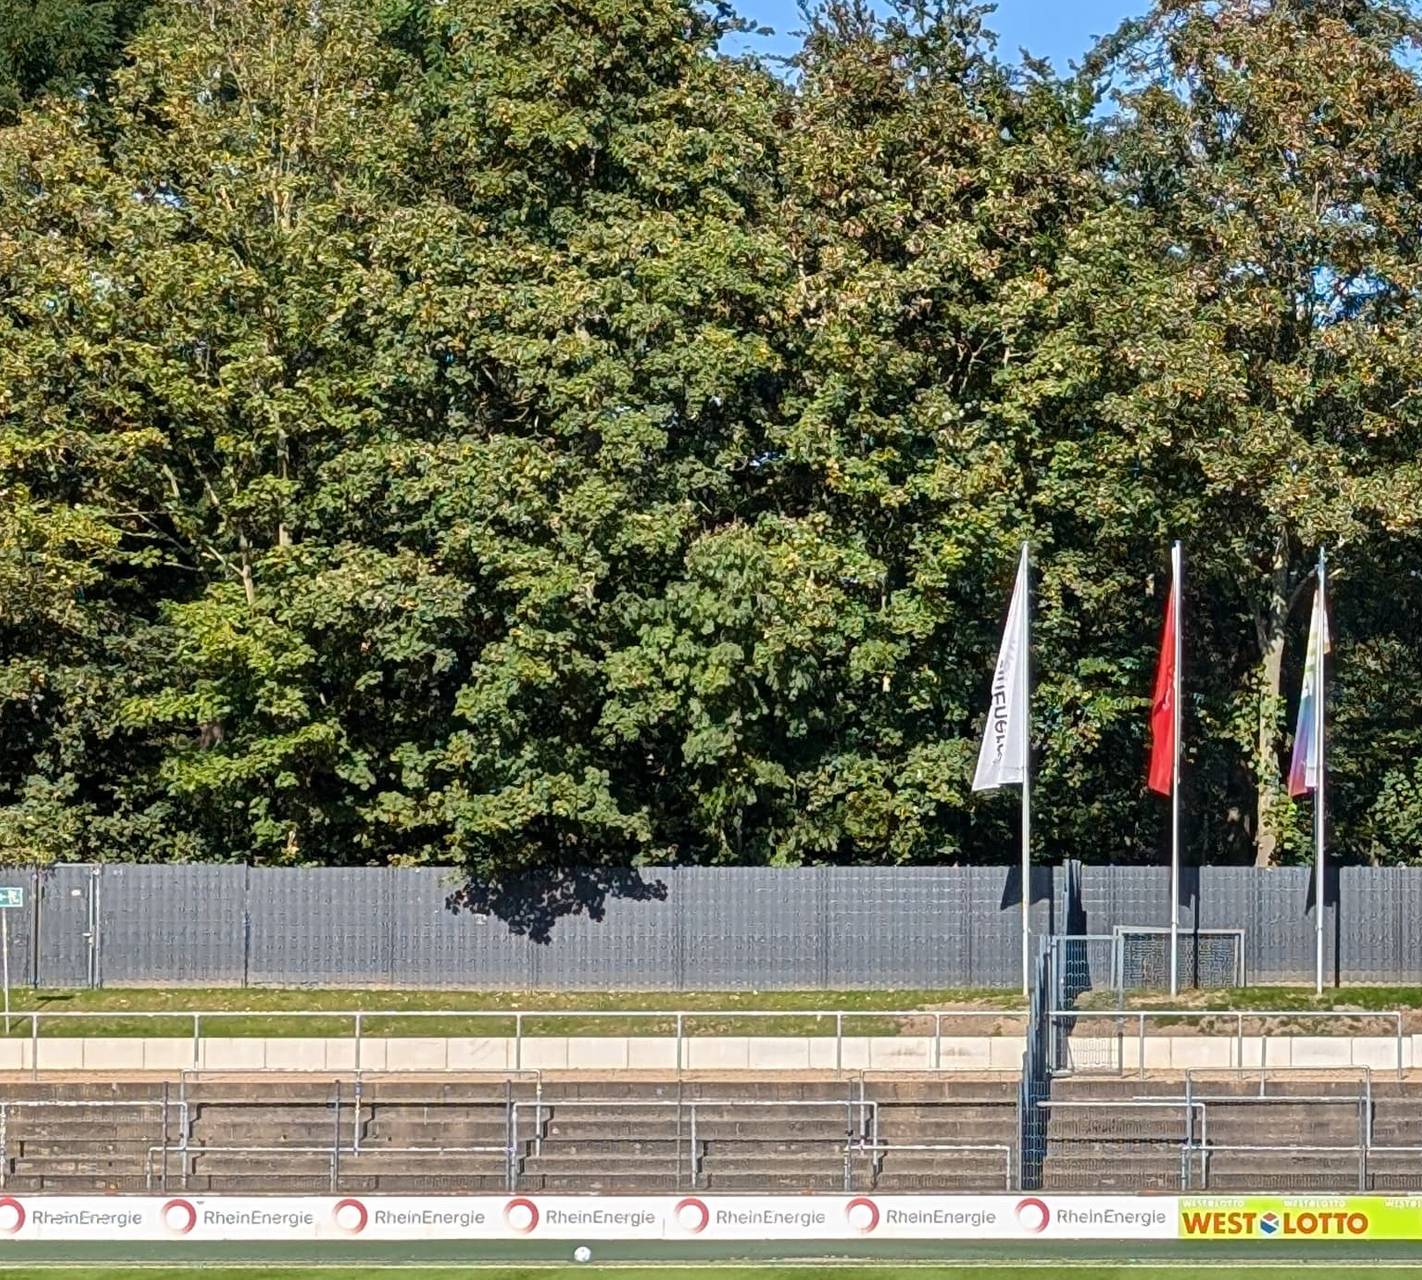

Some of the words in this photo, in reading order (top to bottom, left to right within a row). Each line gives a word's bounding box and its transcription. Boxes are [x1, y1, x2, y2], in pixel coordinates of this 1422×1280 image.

[33, 1211, 141, 1227] RheinEnergie
[204, 1211, 313, 1227] RheinEnergie
[376, 1211, 485, 1227] RheinEnergie
[547, 1210, 655, 1227] RheinEnergie
[717, 1210, 825, 1227] RheinEnergie
[887, 1210, 996, 1226] RheinEnergie
[1057, 1209, 1166, 1226] RheinEnergie
[1182, 1212, 1257, 1235] WEST
[1284, 1212, 1369, 1235] LOTTO
